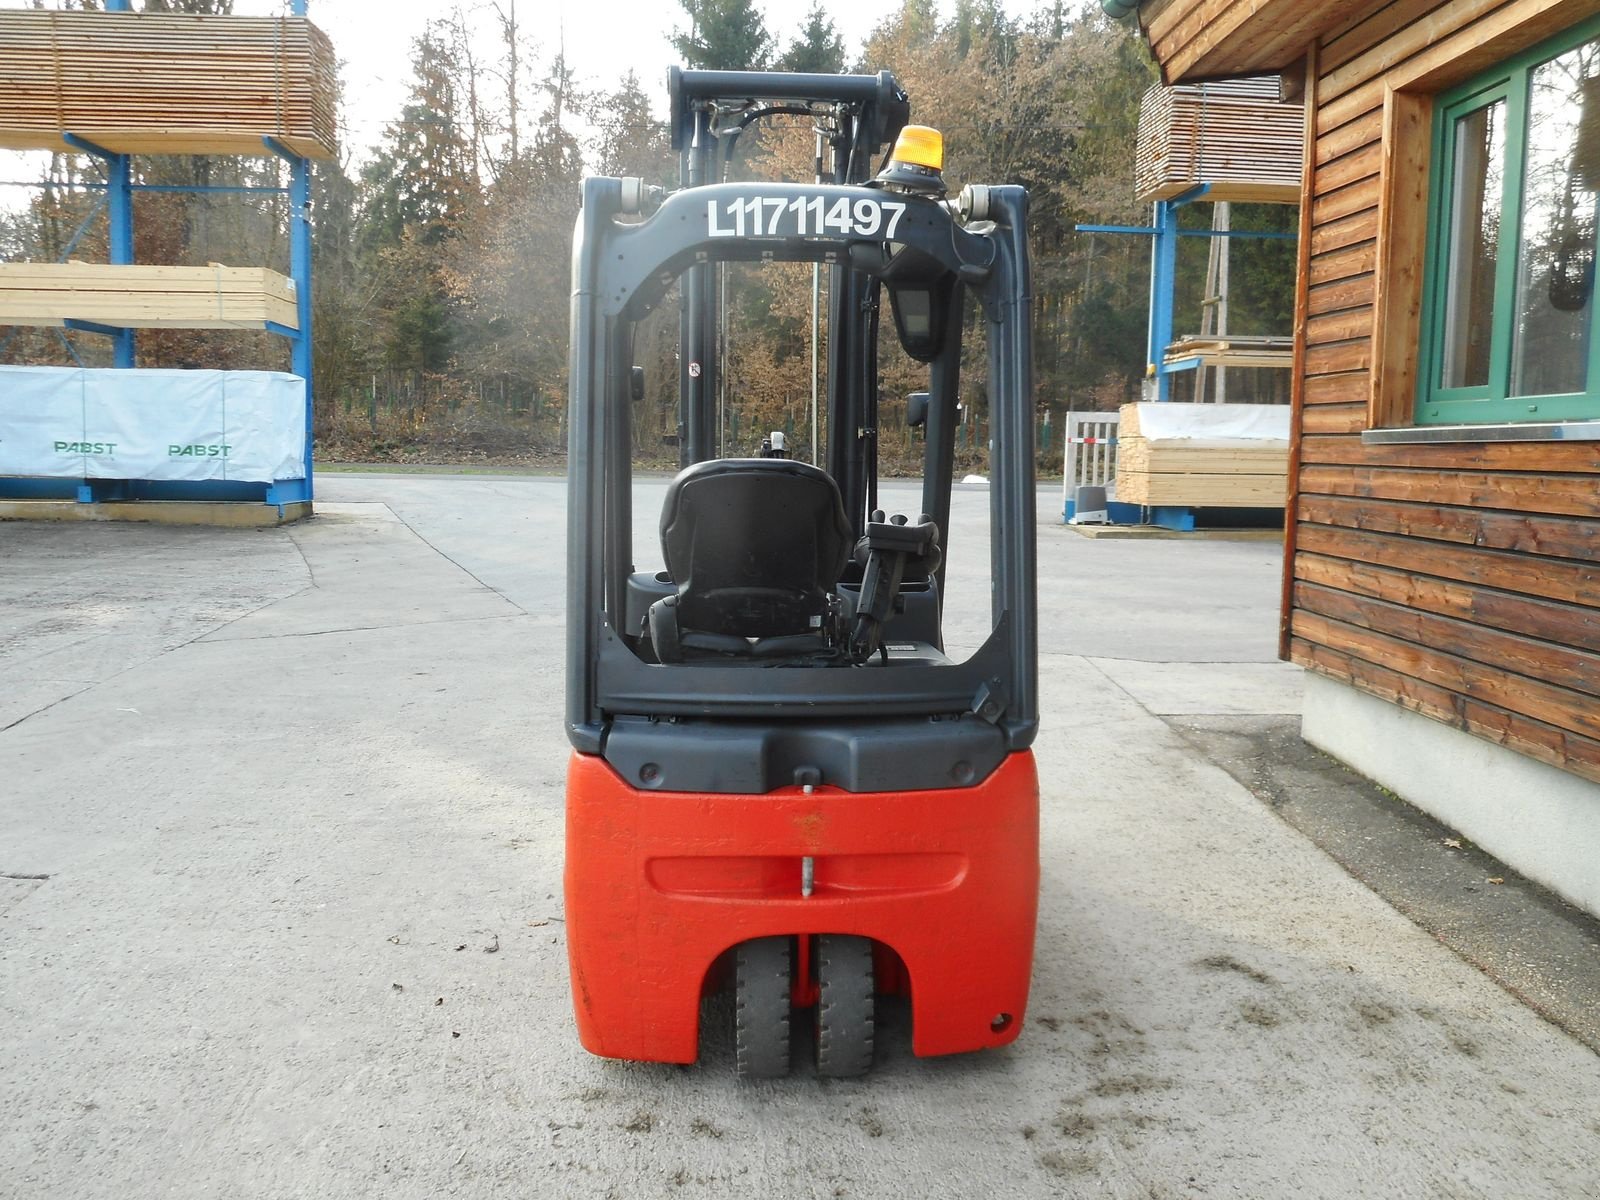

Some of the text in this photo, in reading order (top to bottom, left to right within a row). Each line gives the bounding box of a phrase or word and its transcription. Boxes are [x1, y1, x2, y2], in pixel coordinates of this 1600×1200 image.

[707, 195, 906, 239] L11711497
[54, 441, 118, 455] PABST
[168, 444, 232, 457] PABST
